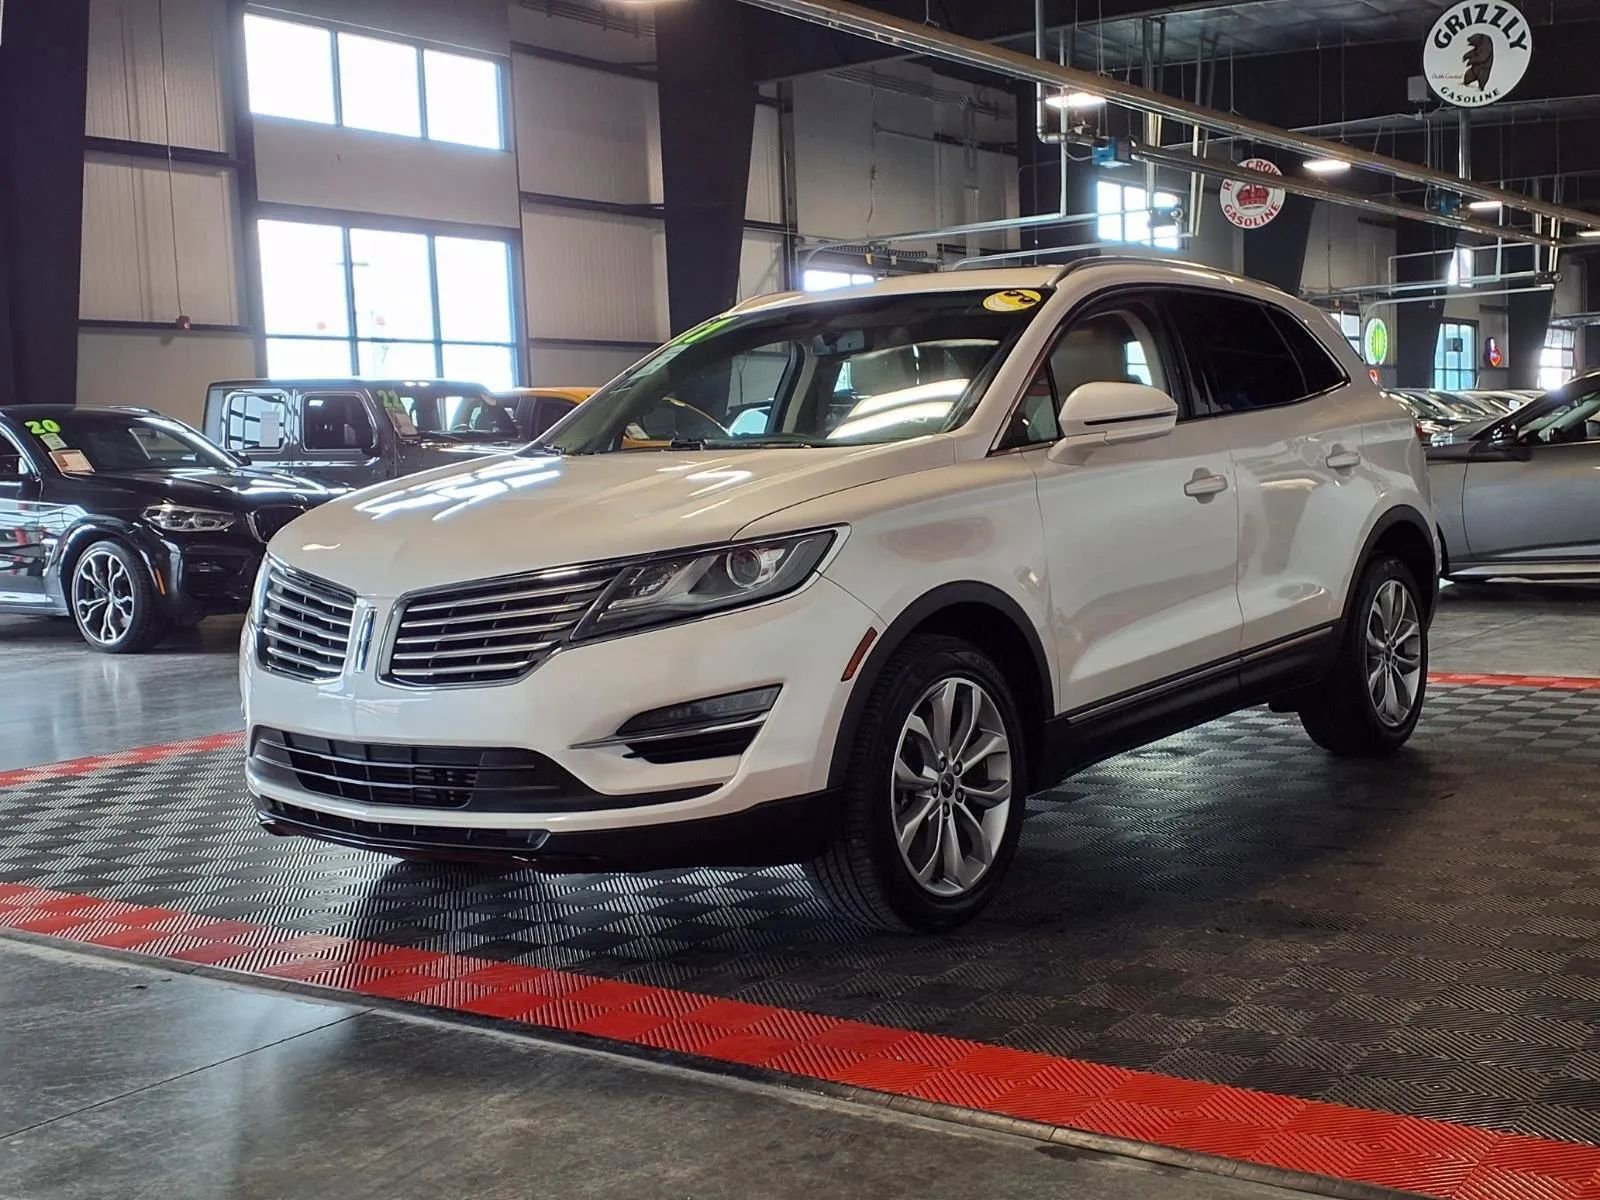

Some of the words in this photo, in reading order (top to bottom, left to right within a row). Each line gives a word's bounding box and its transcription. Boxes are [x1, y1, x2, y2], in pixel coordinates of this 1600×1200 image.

[1434, 3, 1528, 51] GRIZZLY
[1440, 86, 1501, 104] GASOLINE
[1223, 201, 1281, 227] GASOLINE
[24, 419, 61, 435] 20
